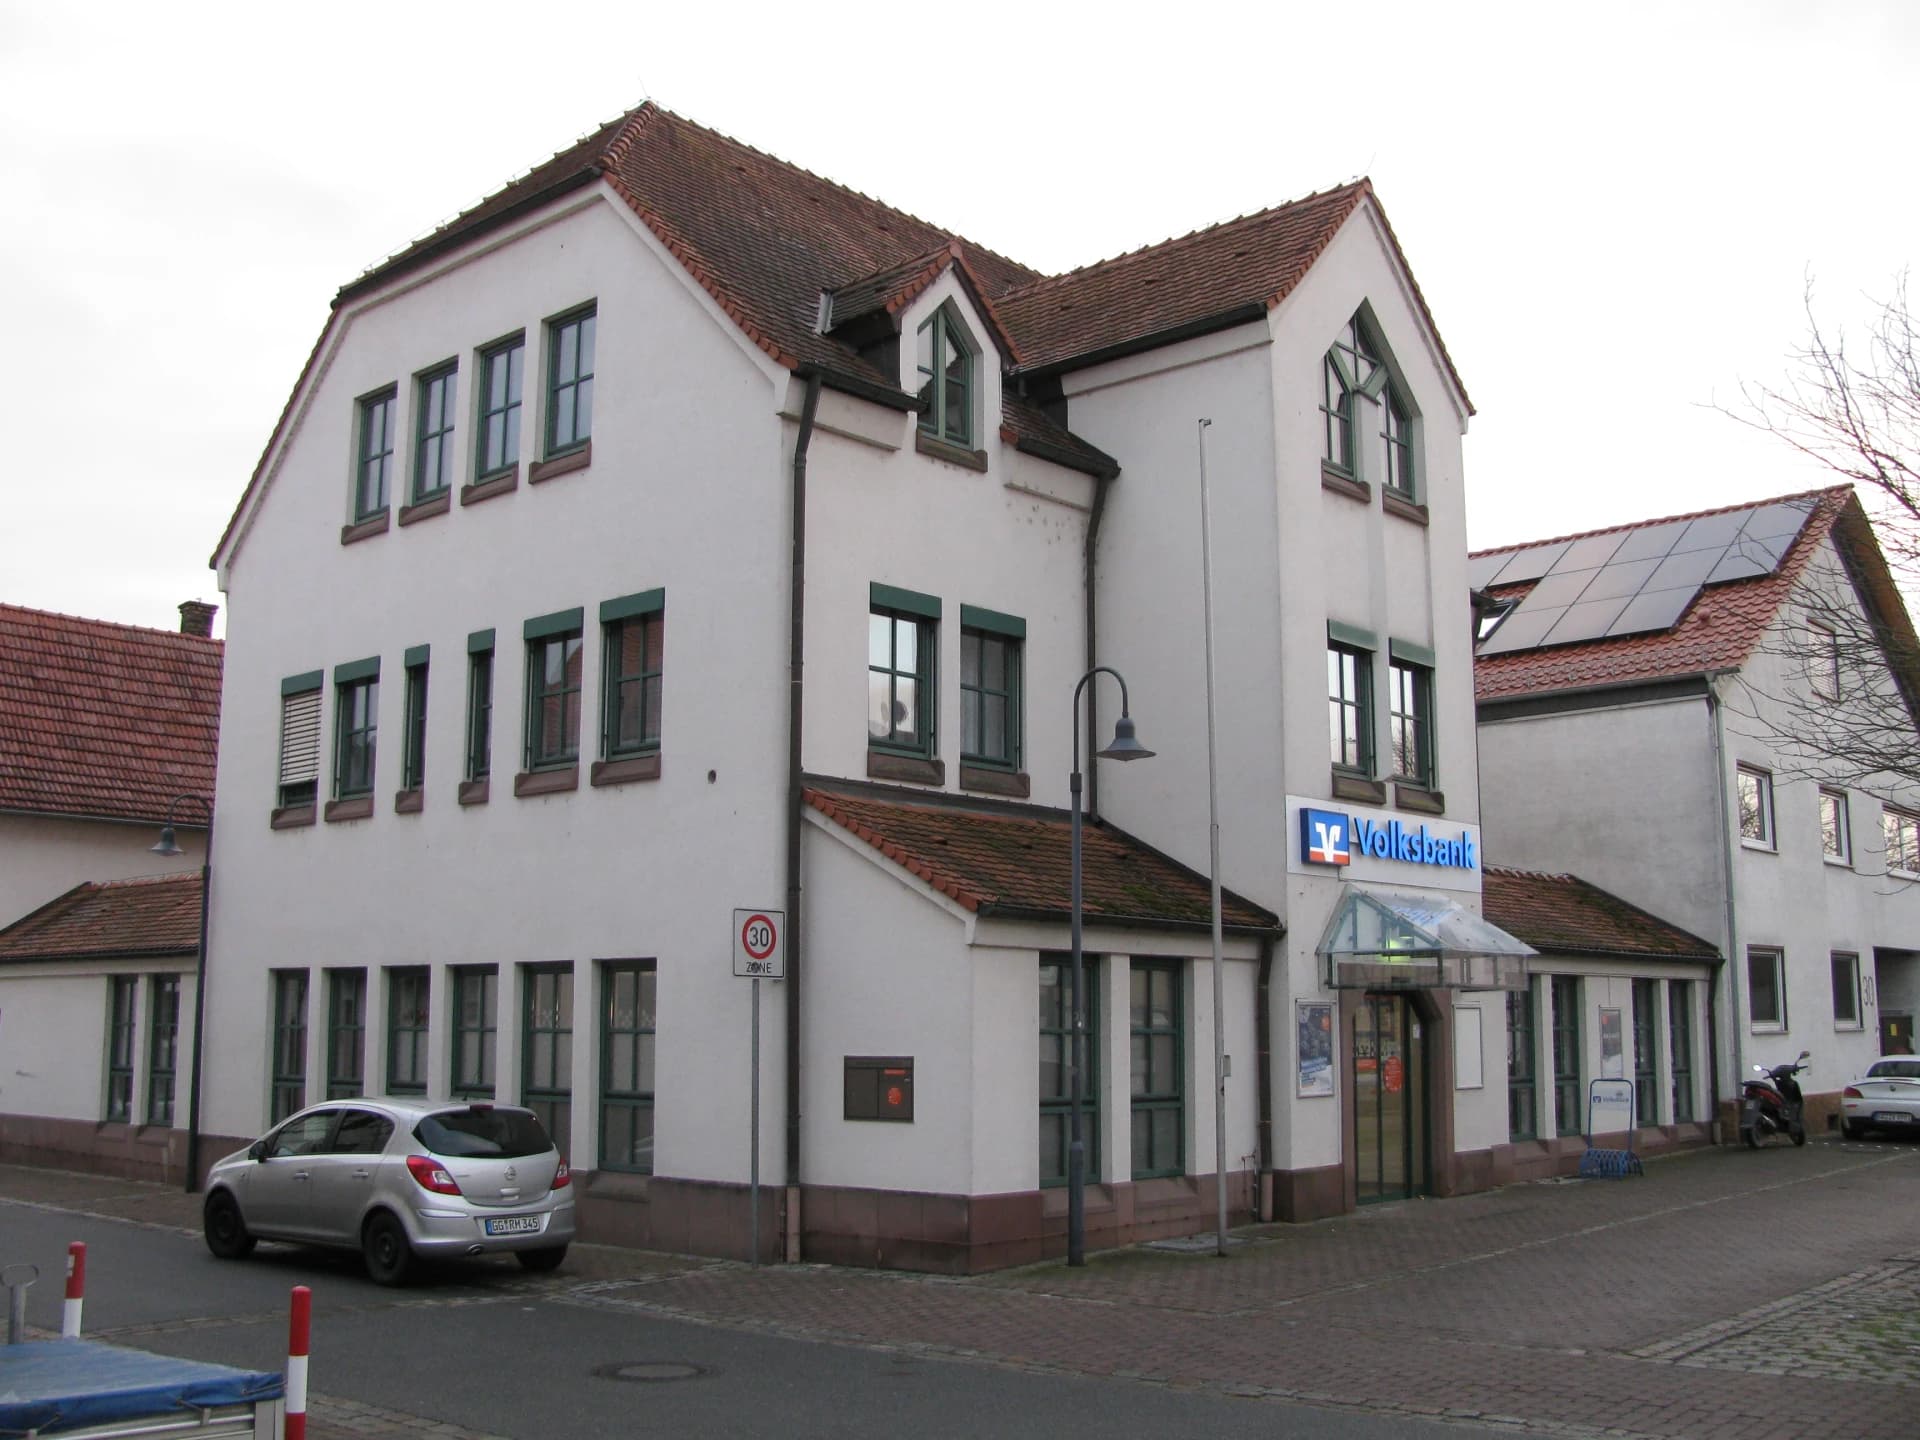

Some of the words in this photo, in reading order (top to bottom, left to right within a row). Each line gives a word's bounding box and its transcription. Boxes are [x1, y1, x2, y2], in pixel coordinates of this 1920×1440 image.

[1354, 817, 1476, 869] Volksbank
[749, 926, 769, 947] 30
[746, 961, 772, 974] ZONE
[1863, 976, 1874, 1006] 30
[493, 1220, 504, 1231] GG
[522, 1217, 538, 1229] 345
